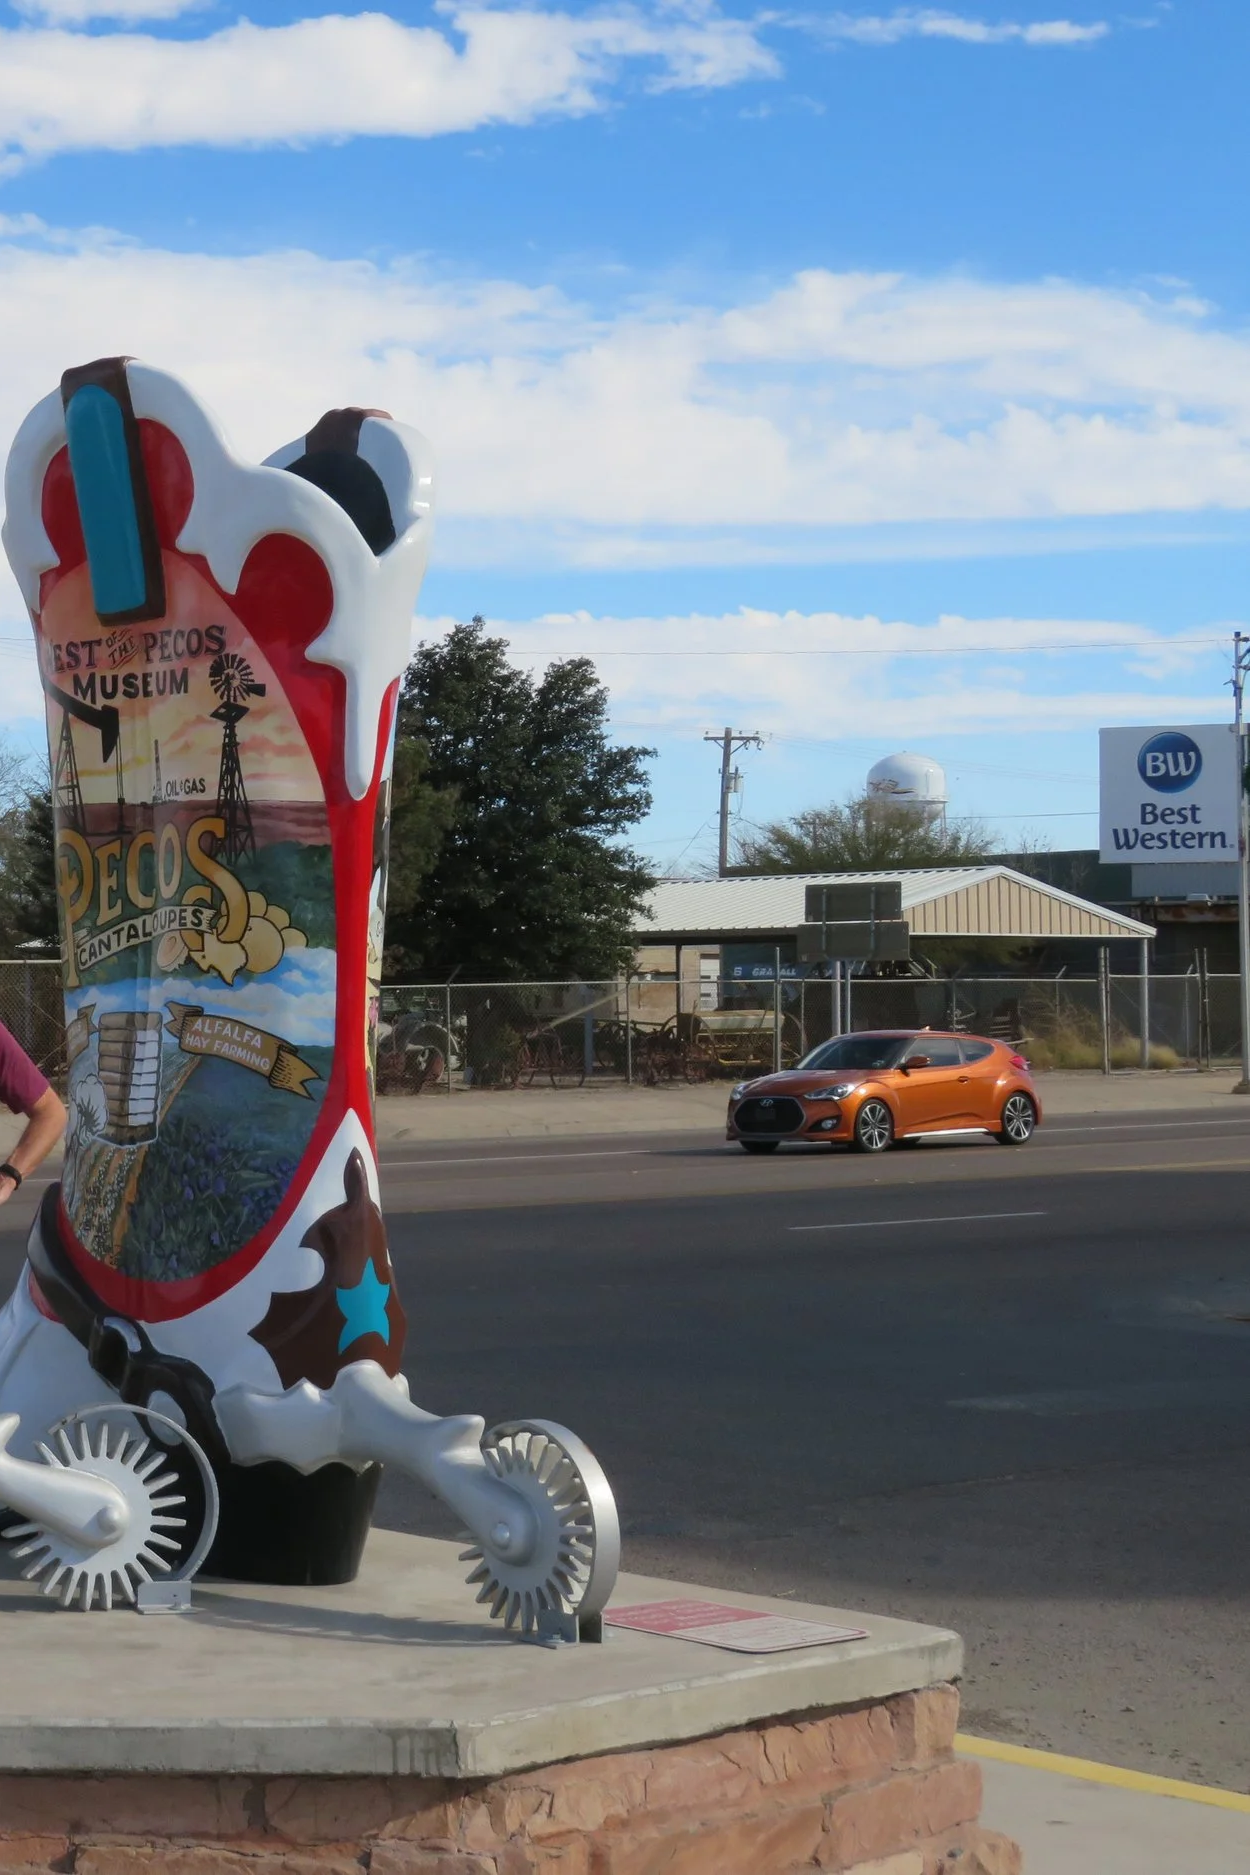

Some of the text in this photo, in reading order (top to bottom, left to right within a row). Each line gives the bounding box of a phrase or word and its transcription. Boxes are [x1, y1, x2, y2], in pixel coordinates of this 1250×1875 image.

[52, 624, 227, 673] EST OF THE PECOS
[73, 667, 189, 705] MUSEUM
[1146, 751, 1197, 777] BW
[165, 780, 180, 797] OIL
[183, 777, 206, 795] GAS
[1140, 802, 1202, 825] Best
[1112, 828, 1228, 850] Western
[58, 816, 250, 988] PECOS
[78, 908, 205, 967] CANTALOUPES
[192, 1018, 263, 1049] ALFALFA
[185, 1033, 270, 1070] HAY FARMING
